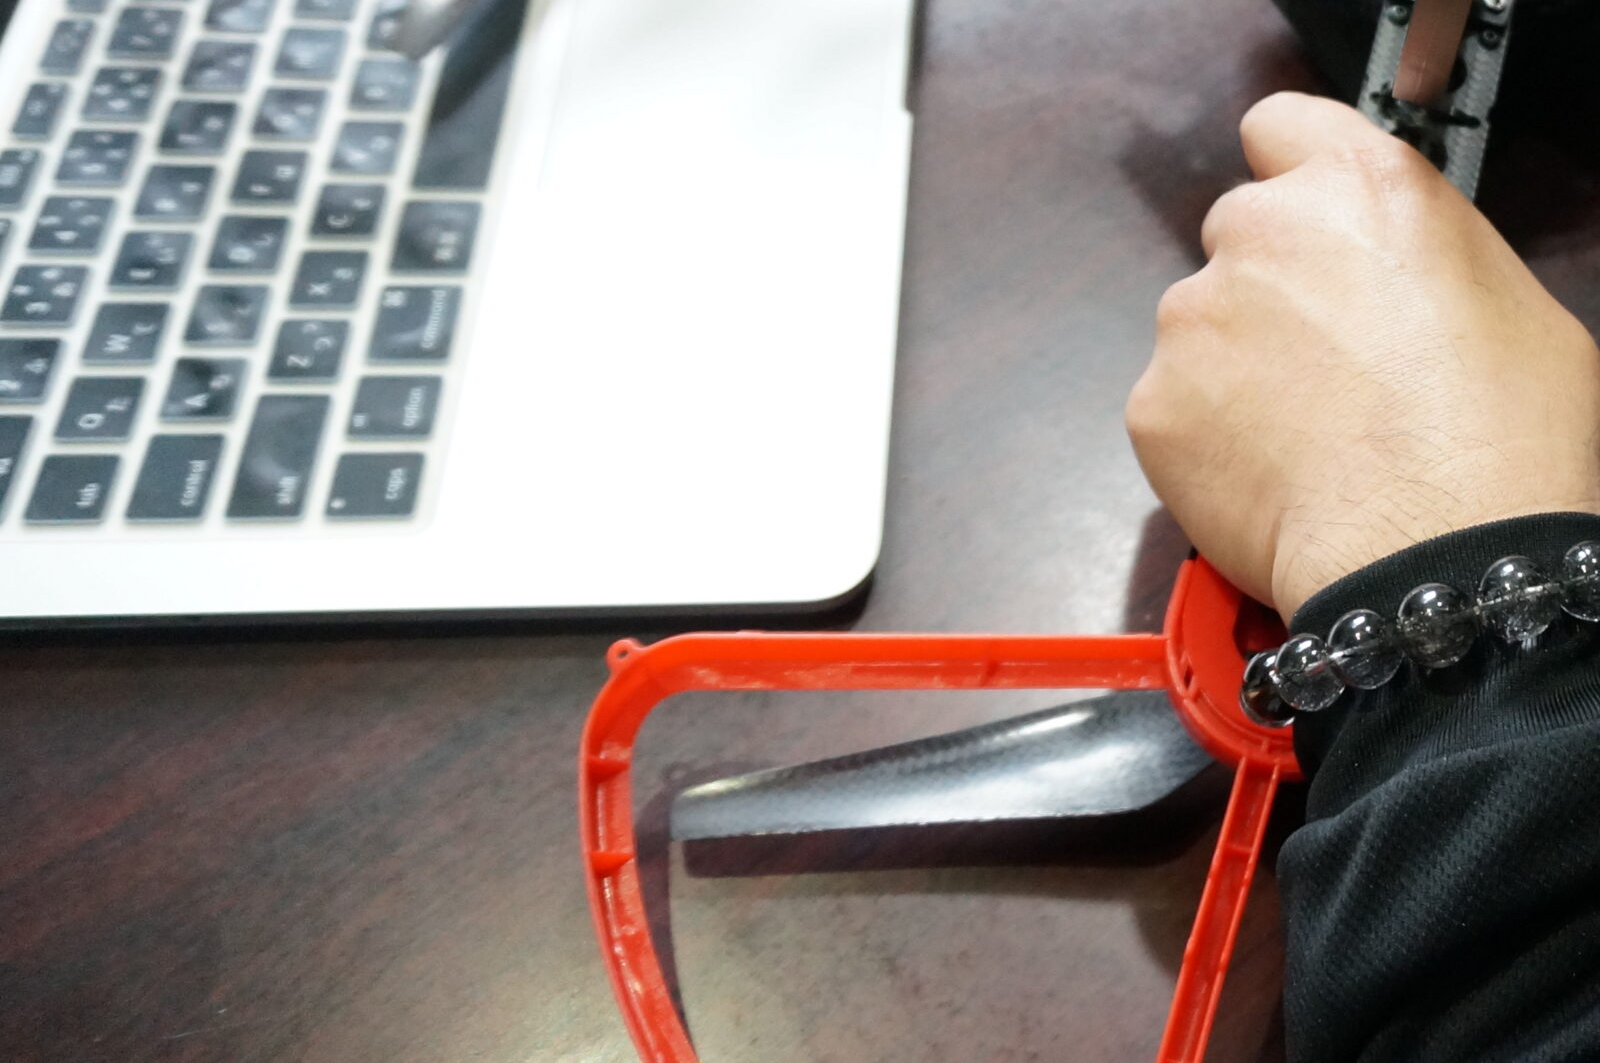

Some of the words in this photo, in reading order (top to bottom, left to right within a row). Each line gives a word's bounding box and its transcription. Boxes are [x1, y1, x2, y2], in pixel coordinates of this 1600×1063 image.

[402, 386, 426, 429] option
[181, 459, 209, 507] control
[385, 467, 406, 500] caps
